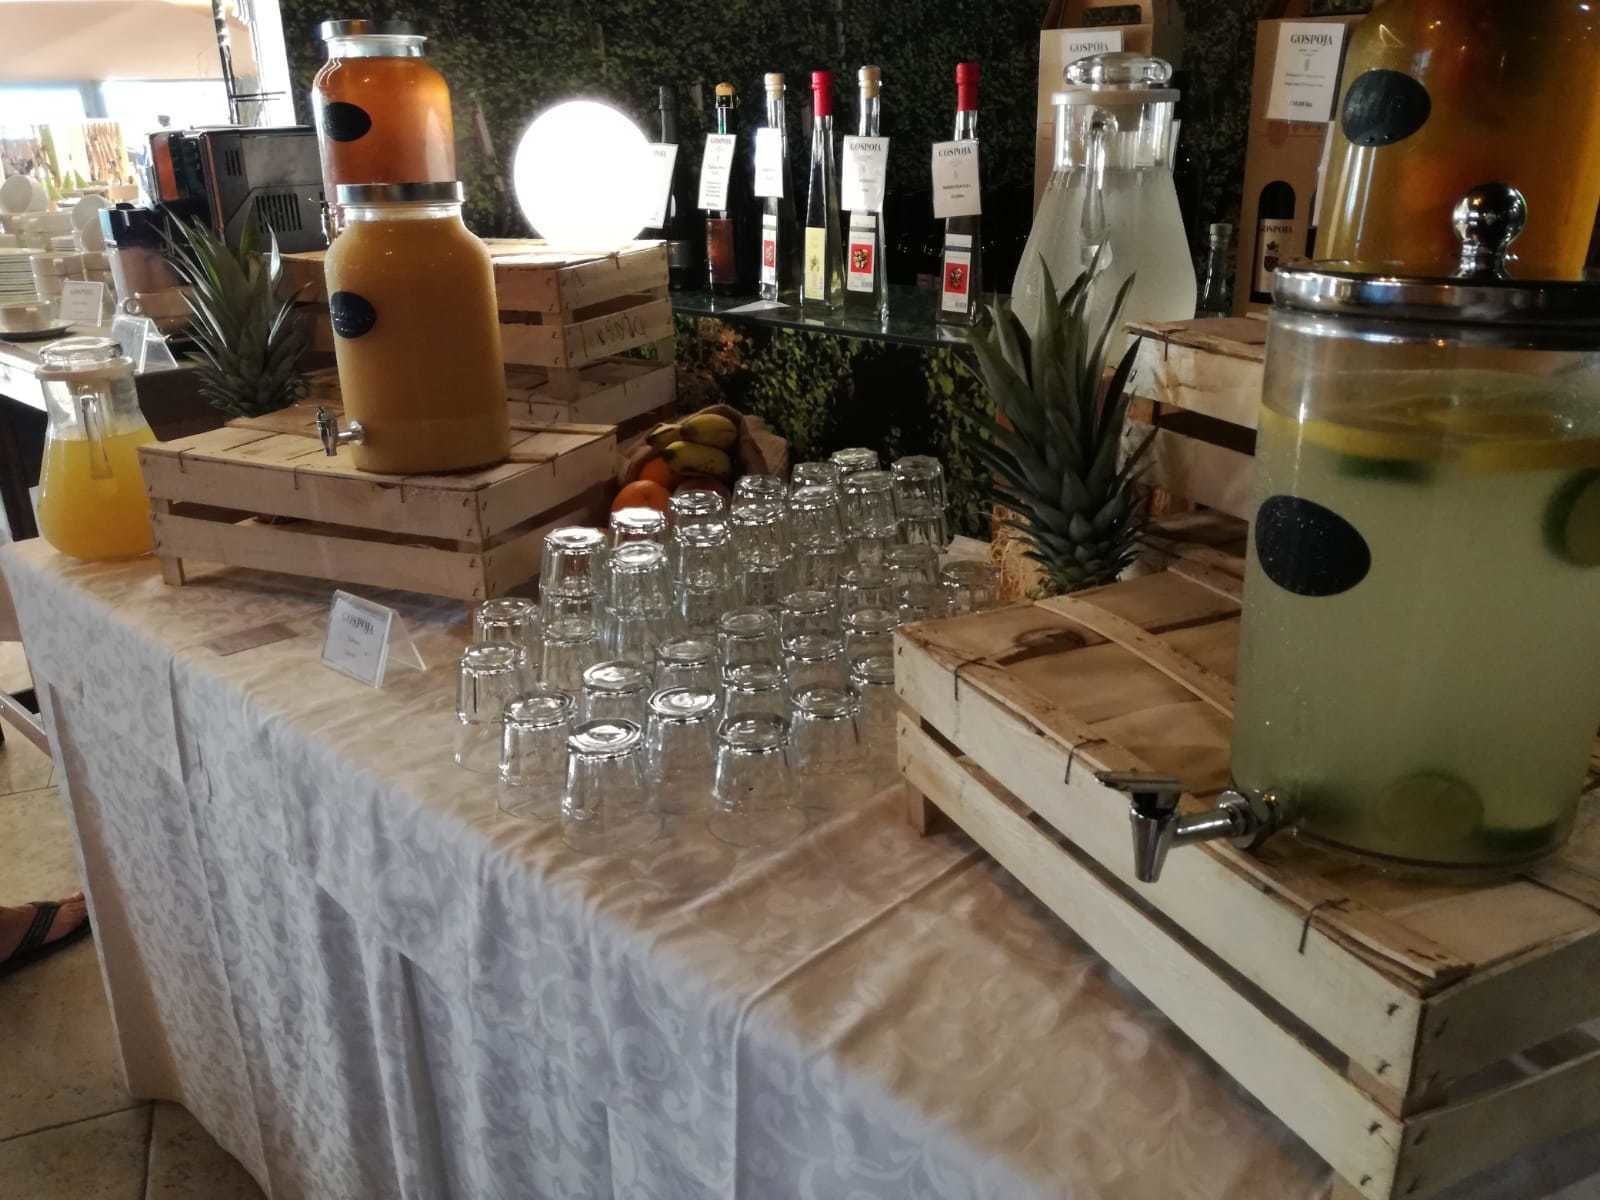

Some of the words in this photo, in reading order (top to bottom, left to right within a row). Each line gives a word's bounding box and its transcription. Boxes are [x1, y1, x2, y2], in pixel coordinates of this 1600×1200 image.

[1290, 33, 1333, 46] GOSPOJA
[1070, 42, 1109, 52] GOSPOJA
[938, 146, 972, 157] GOSPOJA
